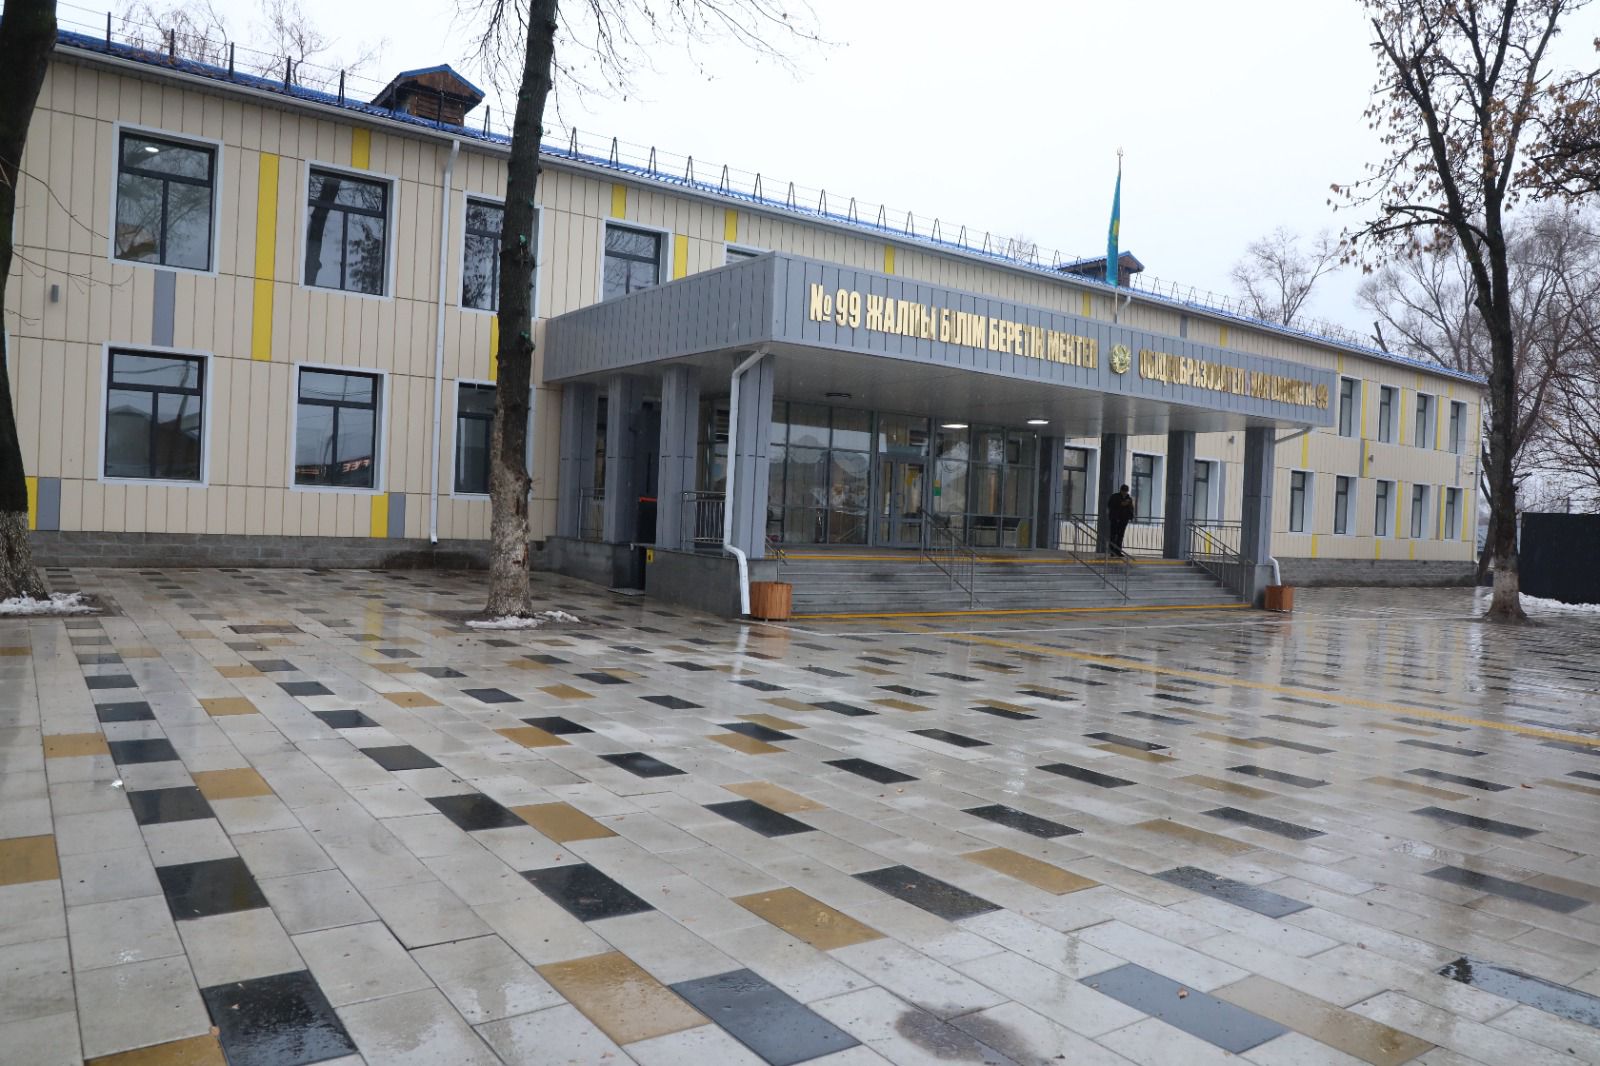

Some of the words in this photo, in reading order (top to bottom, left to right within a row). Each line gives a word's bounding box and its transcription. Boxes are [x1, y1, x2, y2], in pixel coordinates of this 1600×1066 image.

[810, 283, 832, 322] №
[836, 288, 861, 329] 99
[866, 293, 937, 341] ЖАЛПЫ
[940, 307, 986, 350] БІЛІМ
[988, 316, 1044, 360] БЕРЕТІН
[1047, 329, 1098, 368] МЕКТЕП
